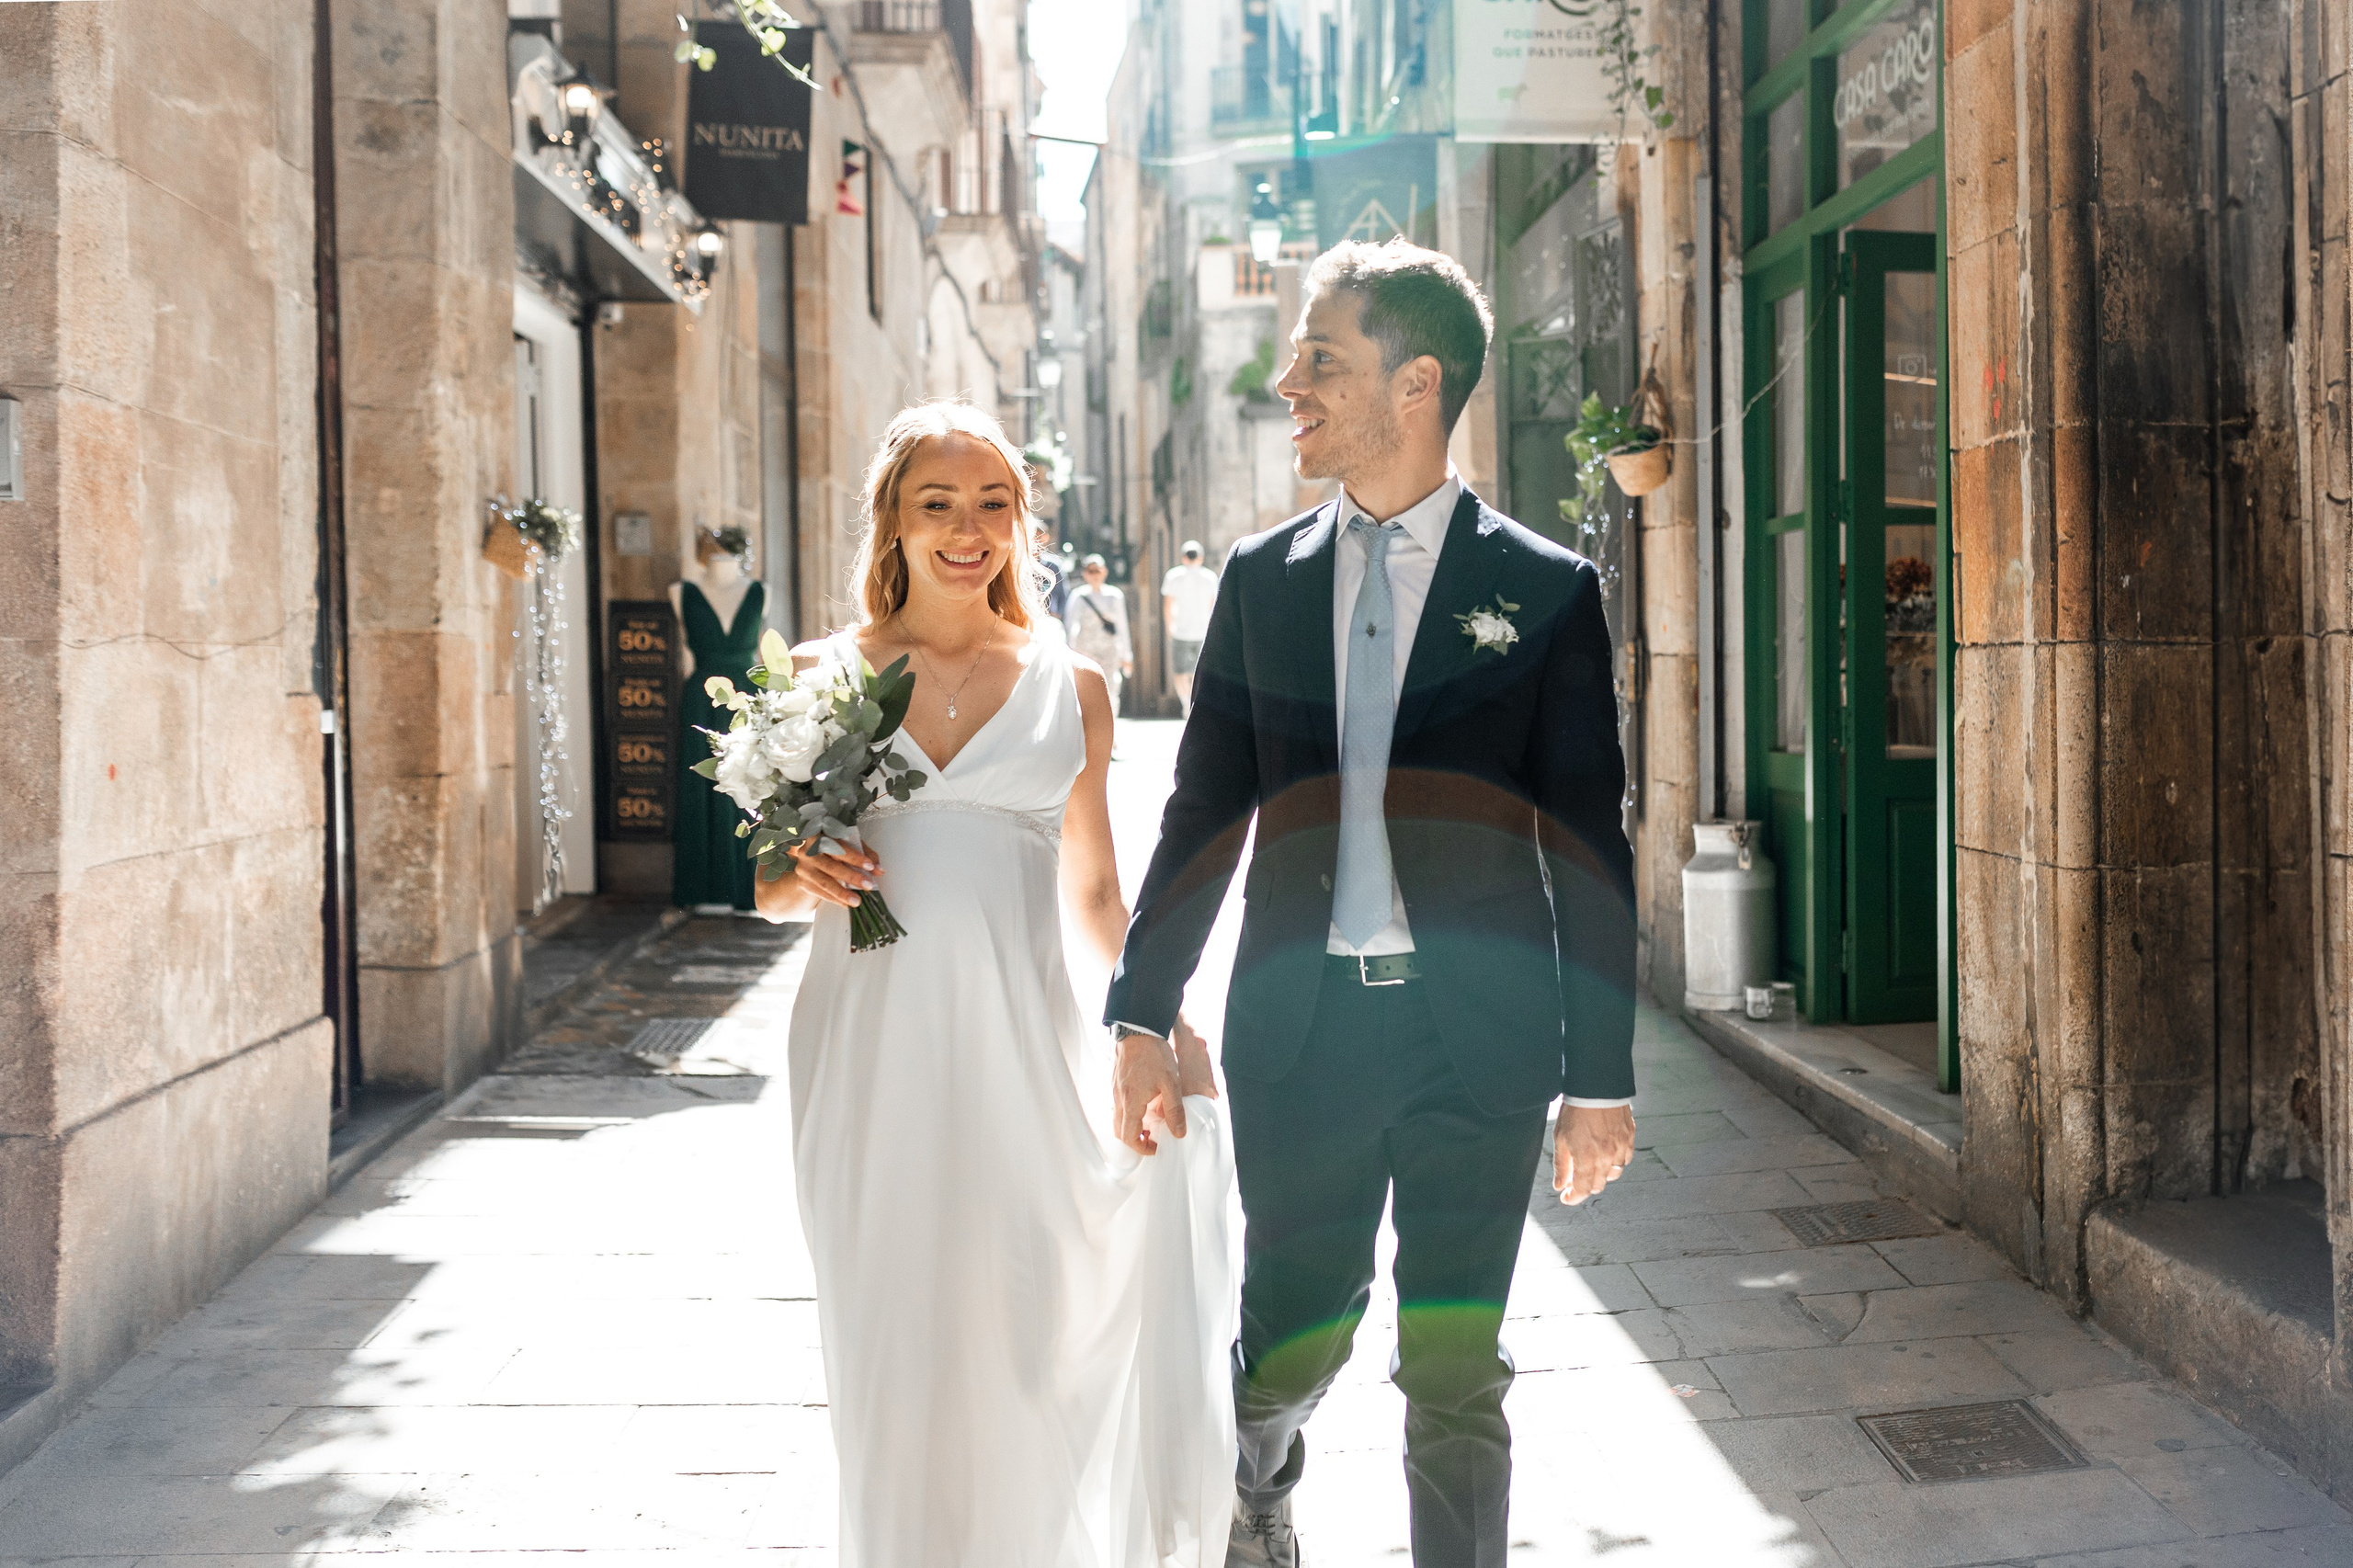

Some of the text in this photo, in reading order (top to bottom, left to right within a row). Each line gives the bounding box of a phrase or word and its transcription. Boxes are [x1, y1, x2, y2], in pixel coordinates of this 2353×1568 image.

[1528, 47, 1605, 57] PASTURE
[1833, 62, 1878, 129] CASA
[1881, 13, 1937, 93] CARO
[694, 122, 804, 152] NUNITA
